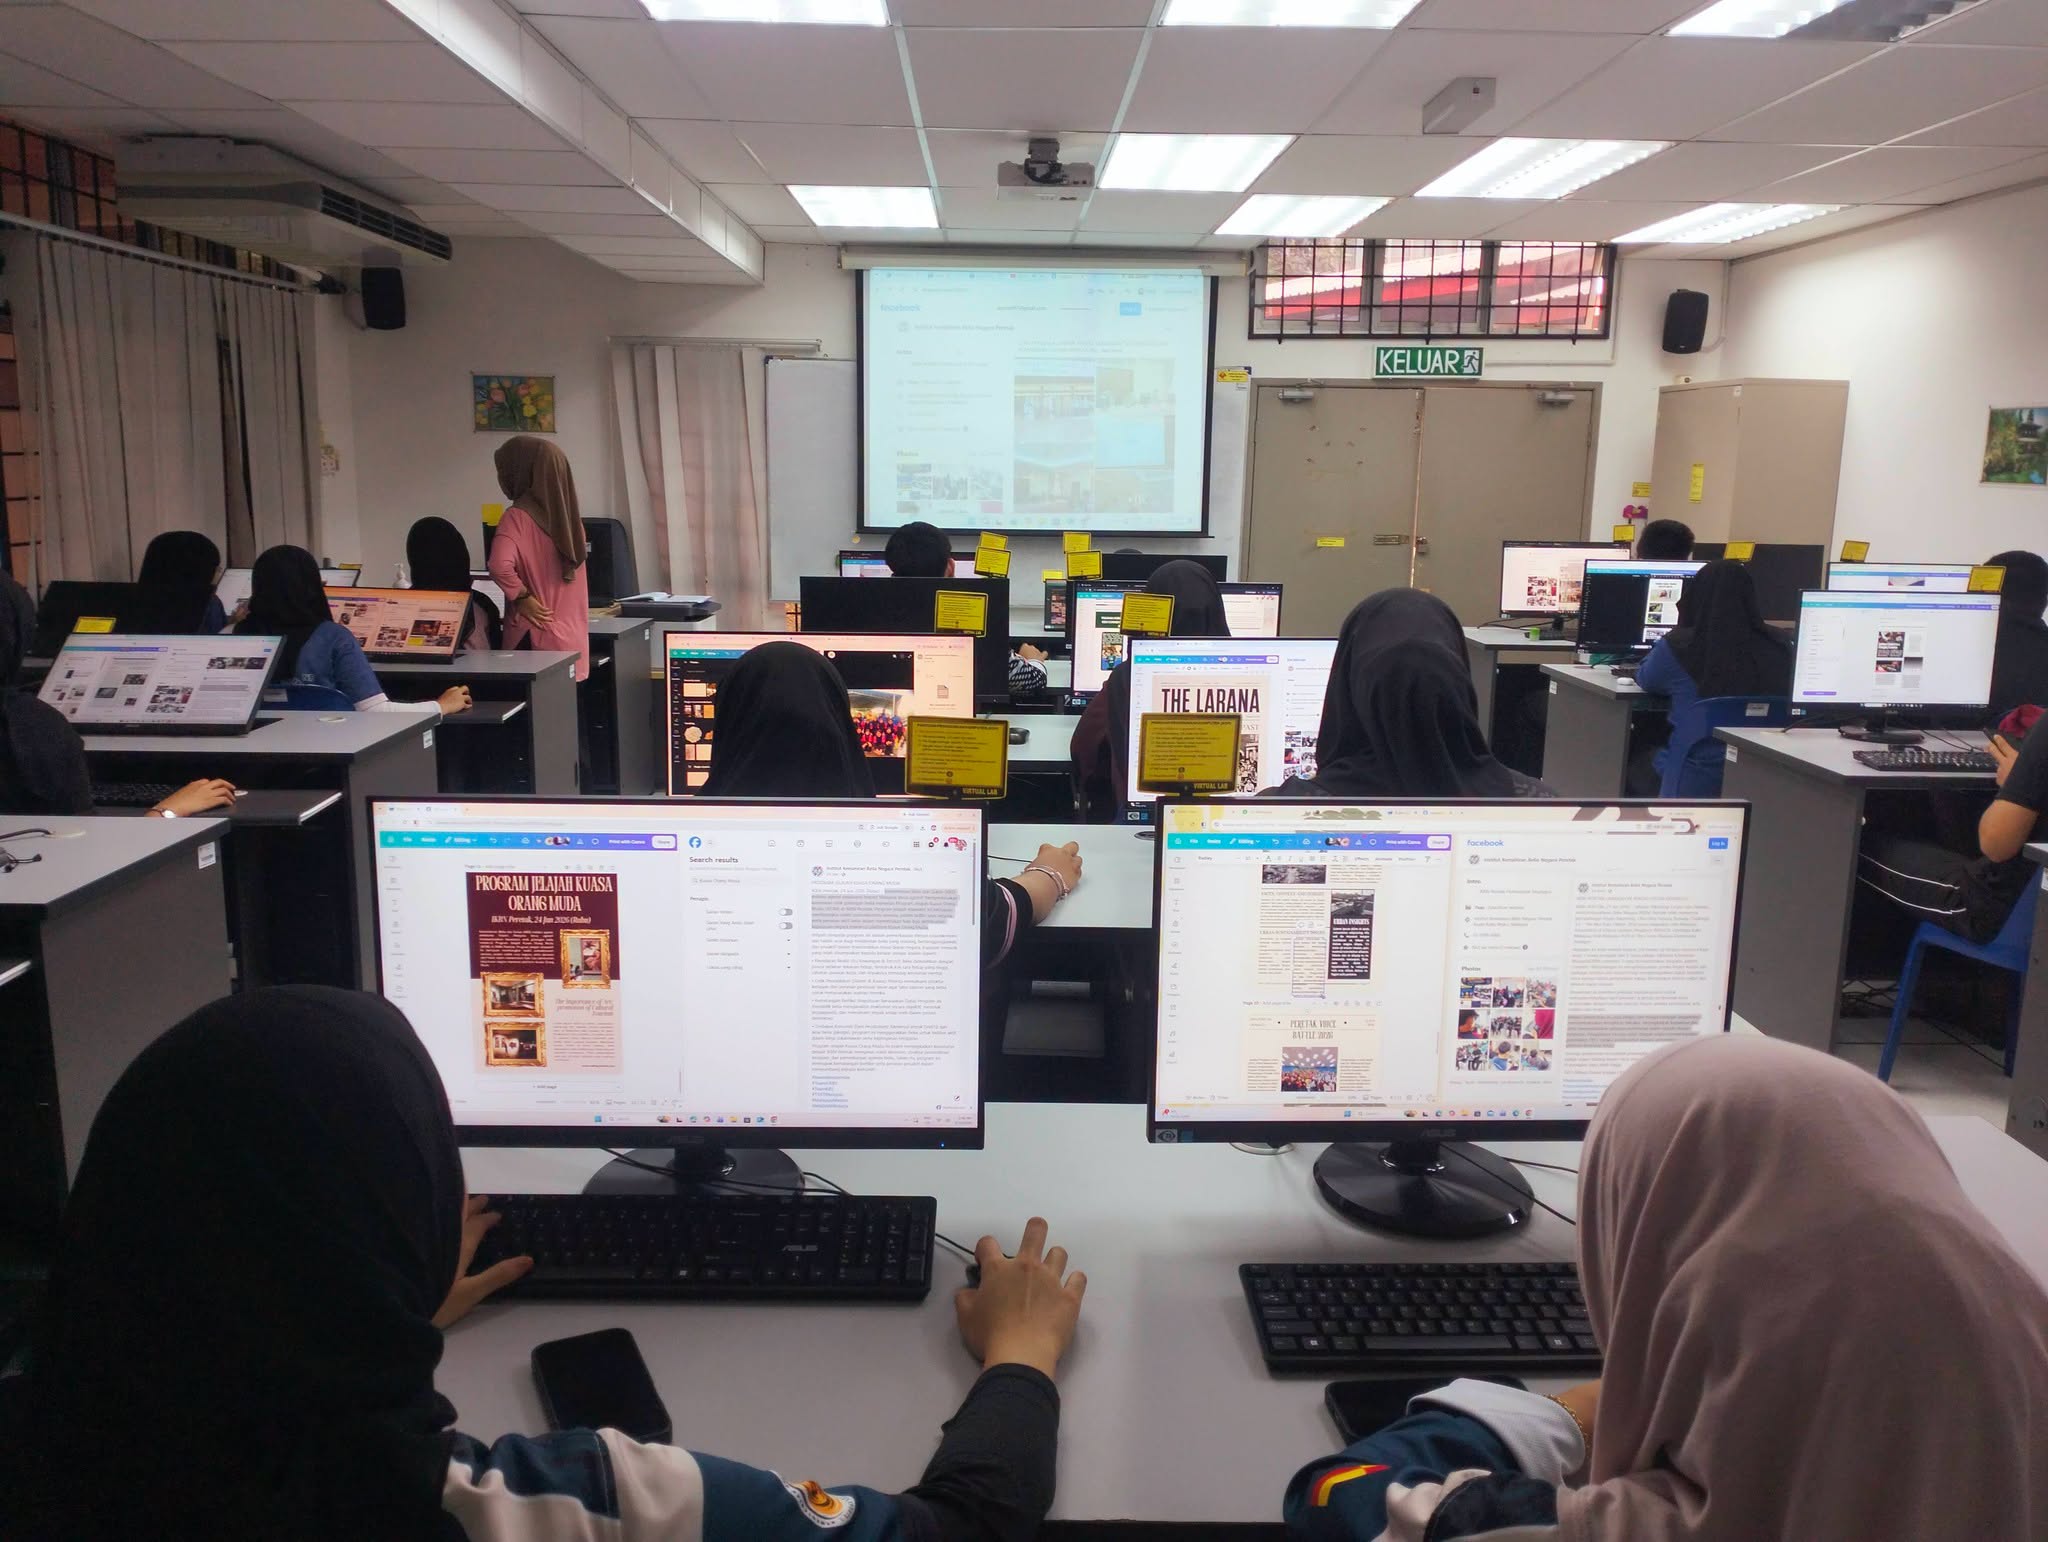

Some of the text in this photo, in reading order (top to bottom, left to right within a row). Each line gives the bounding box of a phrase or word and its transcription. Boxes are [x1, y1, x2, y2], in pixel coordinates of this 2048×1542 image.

[880, 304, 921, 312] facebook
[1379, 349, 1460, 374] KELUAR
[1161, 688, 1260, 713] THE LARANA
[962, 787, 986, 795] VIRTUAL
[1193, 782, 1228, 790] VIRTUAL LAB
[1466, 839, 1505, 847] facebook
[475, 875, 613, 894] PROGRAM JELAJAH KUASA
[508, 895, 582, 912] ORANG MUDA
[1290, 1019, 1337, 1029] PERETAK VOICE
[1292, 1030, 1316, 1040] BATTLE
